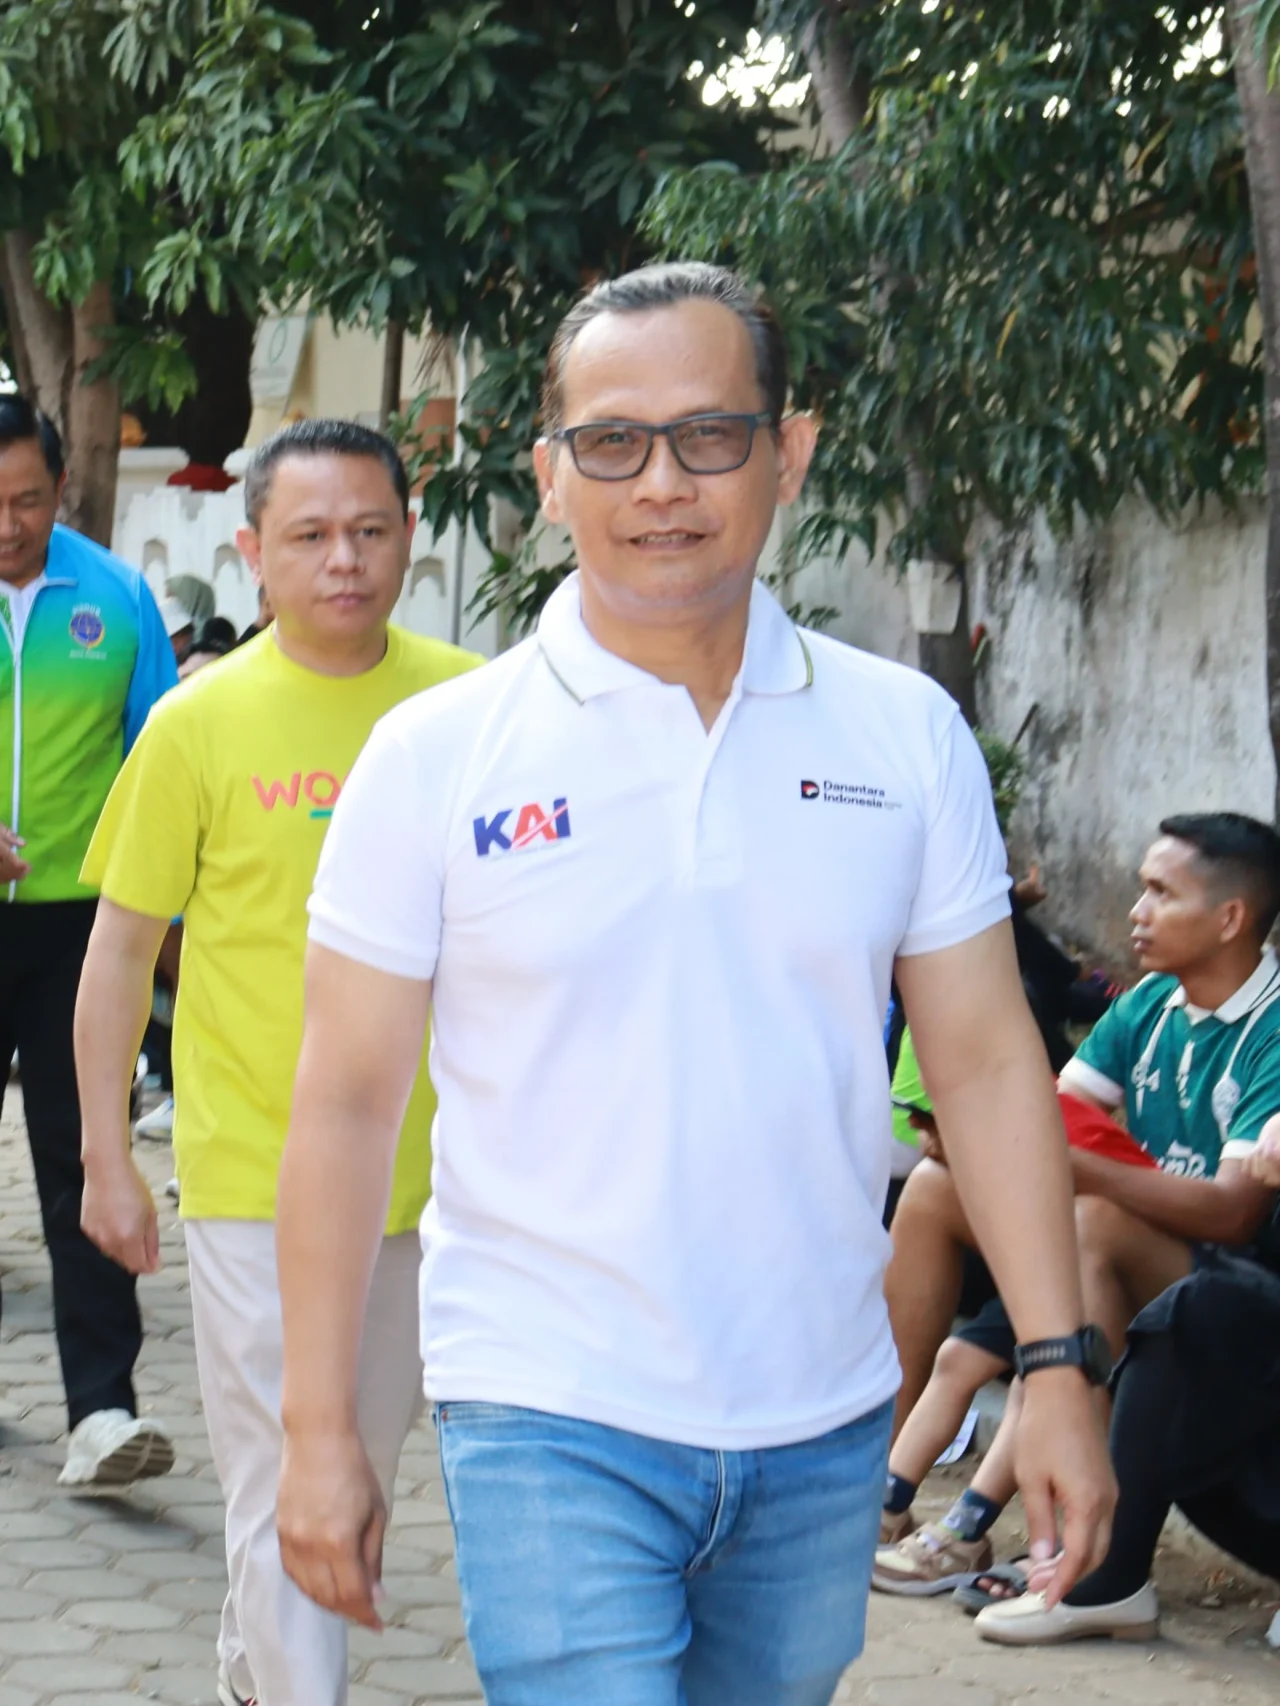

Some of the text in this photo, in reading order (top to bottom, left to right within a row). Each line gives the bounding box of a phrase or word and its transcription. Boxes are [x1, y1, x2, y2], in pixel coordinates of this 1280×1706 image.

[250, 769, 349, 811] WO
[823, 780, 885, 797] Danantara
[823, 793, 882, 809] Indonesia
[473, 797, 571, 857] KAI
